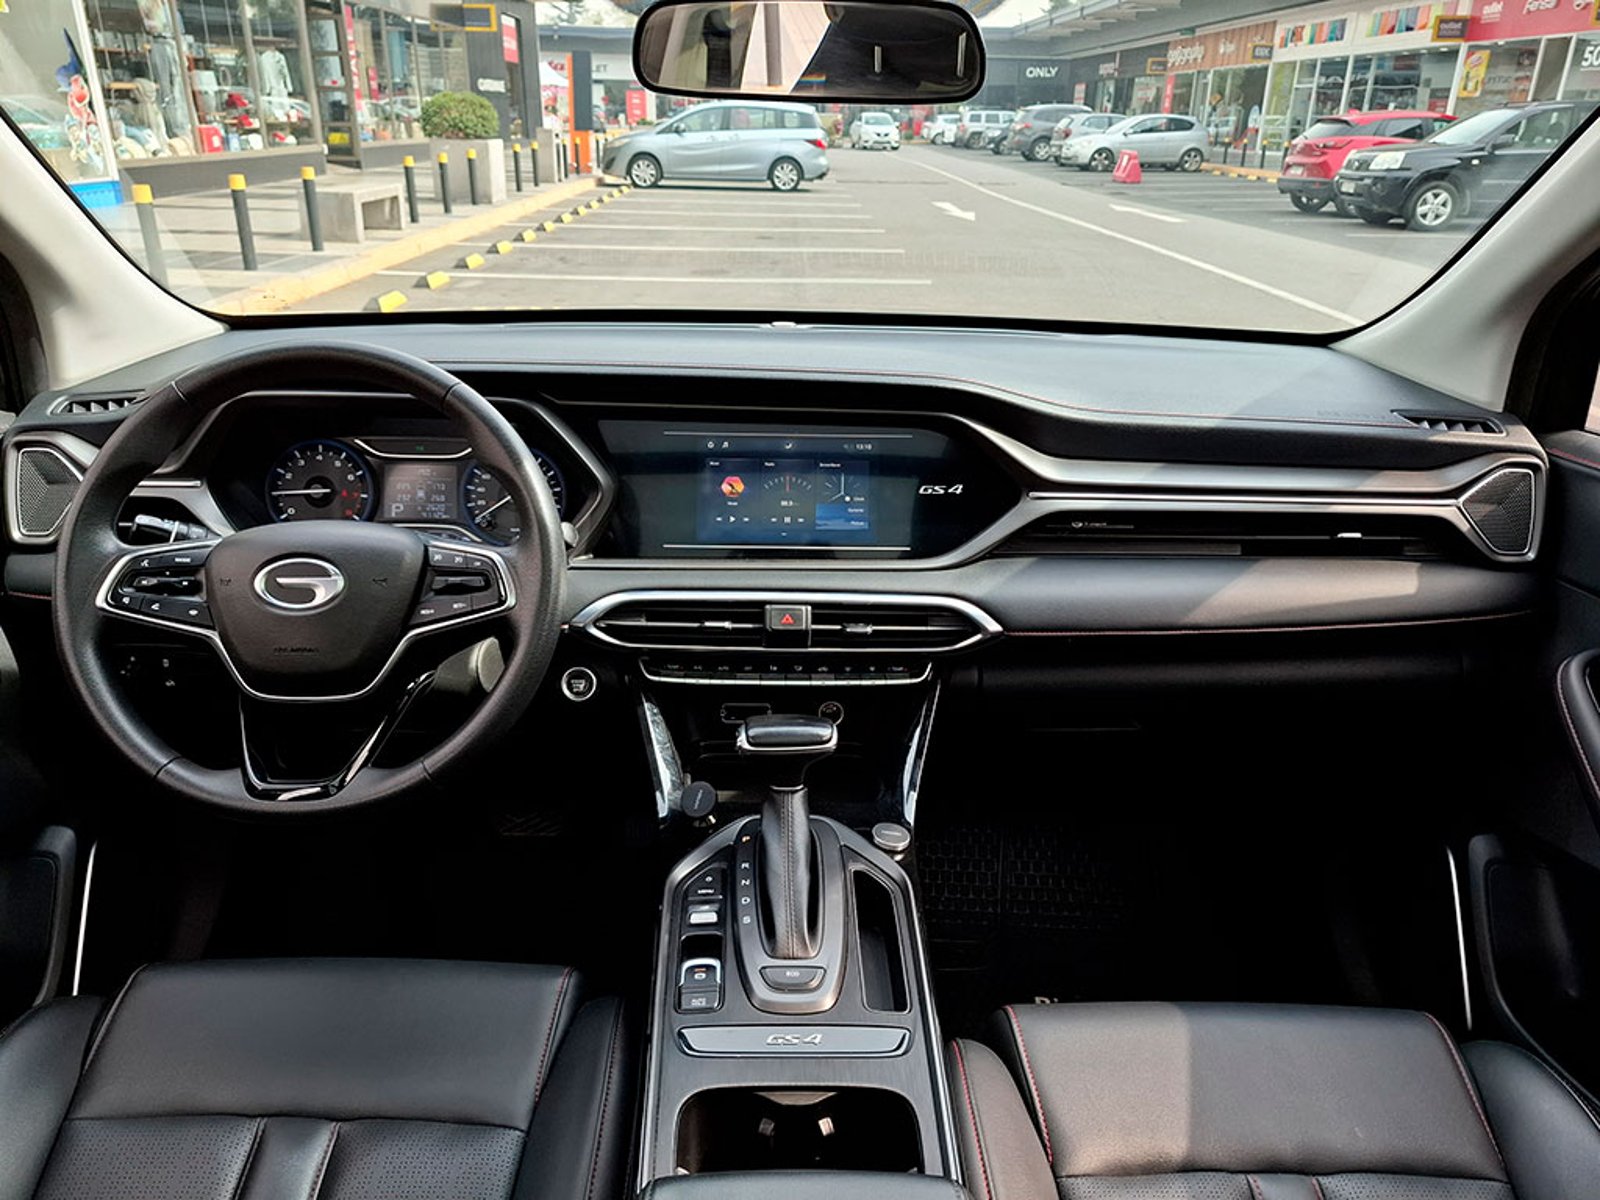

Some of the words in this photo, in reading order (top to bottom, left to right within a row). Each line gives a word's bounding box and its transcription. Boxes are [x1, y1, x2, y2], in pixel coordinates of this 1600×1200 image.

[1026, 66, 1059, 78] ONLY
[391, 502, 404, 517] P
[741, 896, 751, 905] D
